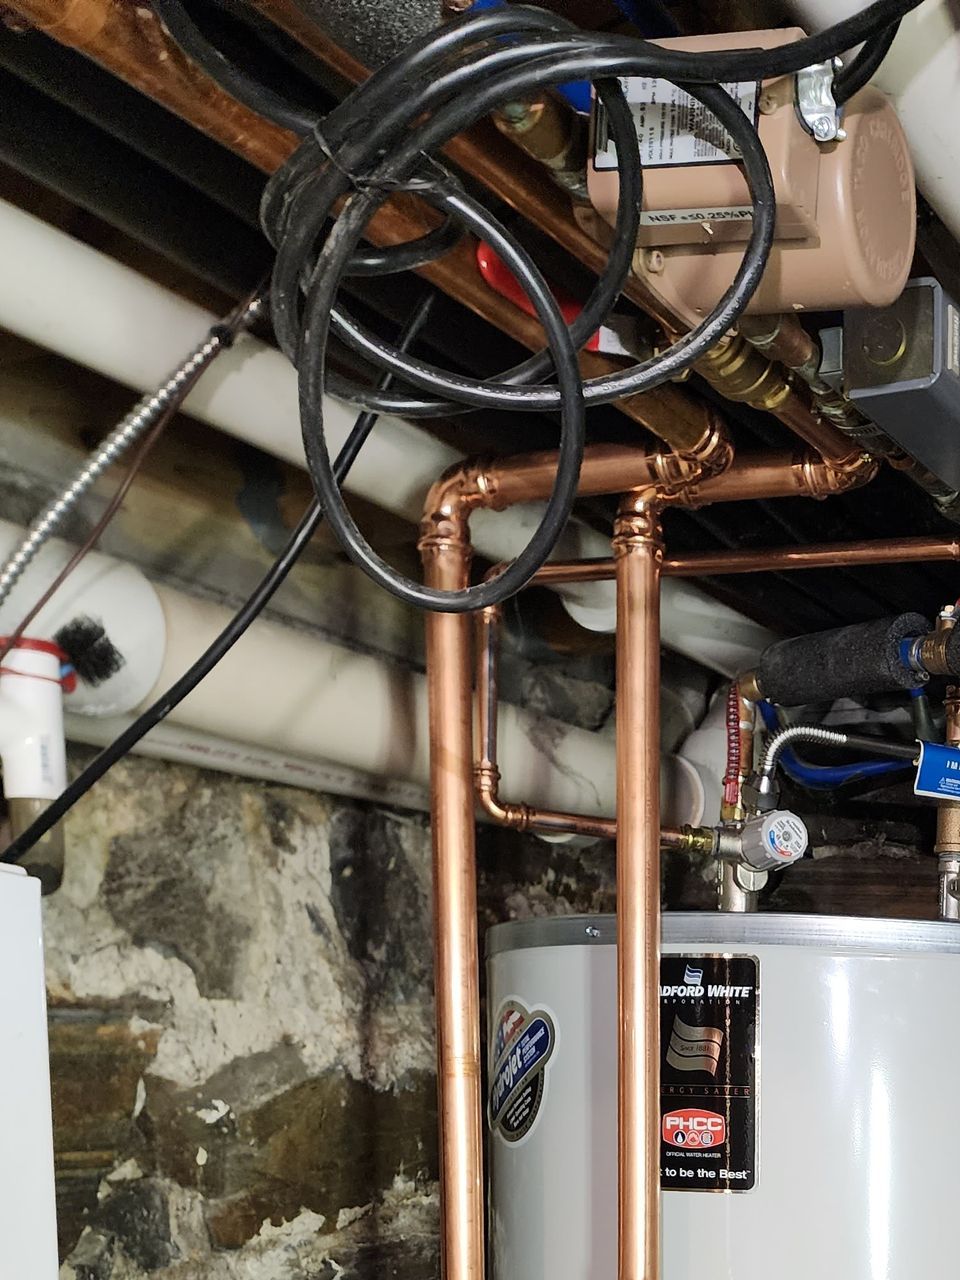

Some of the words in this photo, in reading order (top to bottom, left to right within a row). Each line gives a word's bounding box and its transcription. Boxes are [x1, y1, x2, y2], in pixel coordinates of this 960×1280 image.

[688, 96, 696, 133] WARNIN
[648, 211, 677, 222] NSF
[707, 985, 750, 998] WHITE
[665, 1116, 723, 1131] PHCC
[665, 1167, 677, 1176] to
[679, 1168, 694, 1177] be
[696, 1168, 716, 1178] the
[719, 1169, 747, 1179] Best
